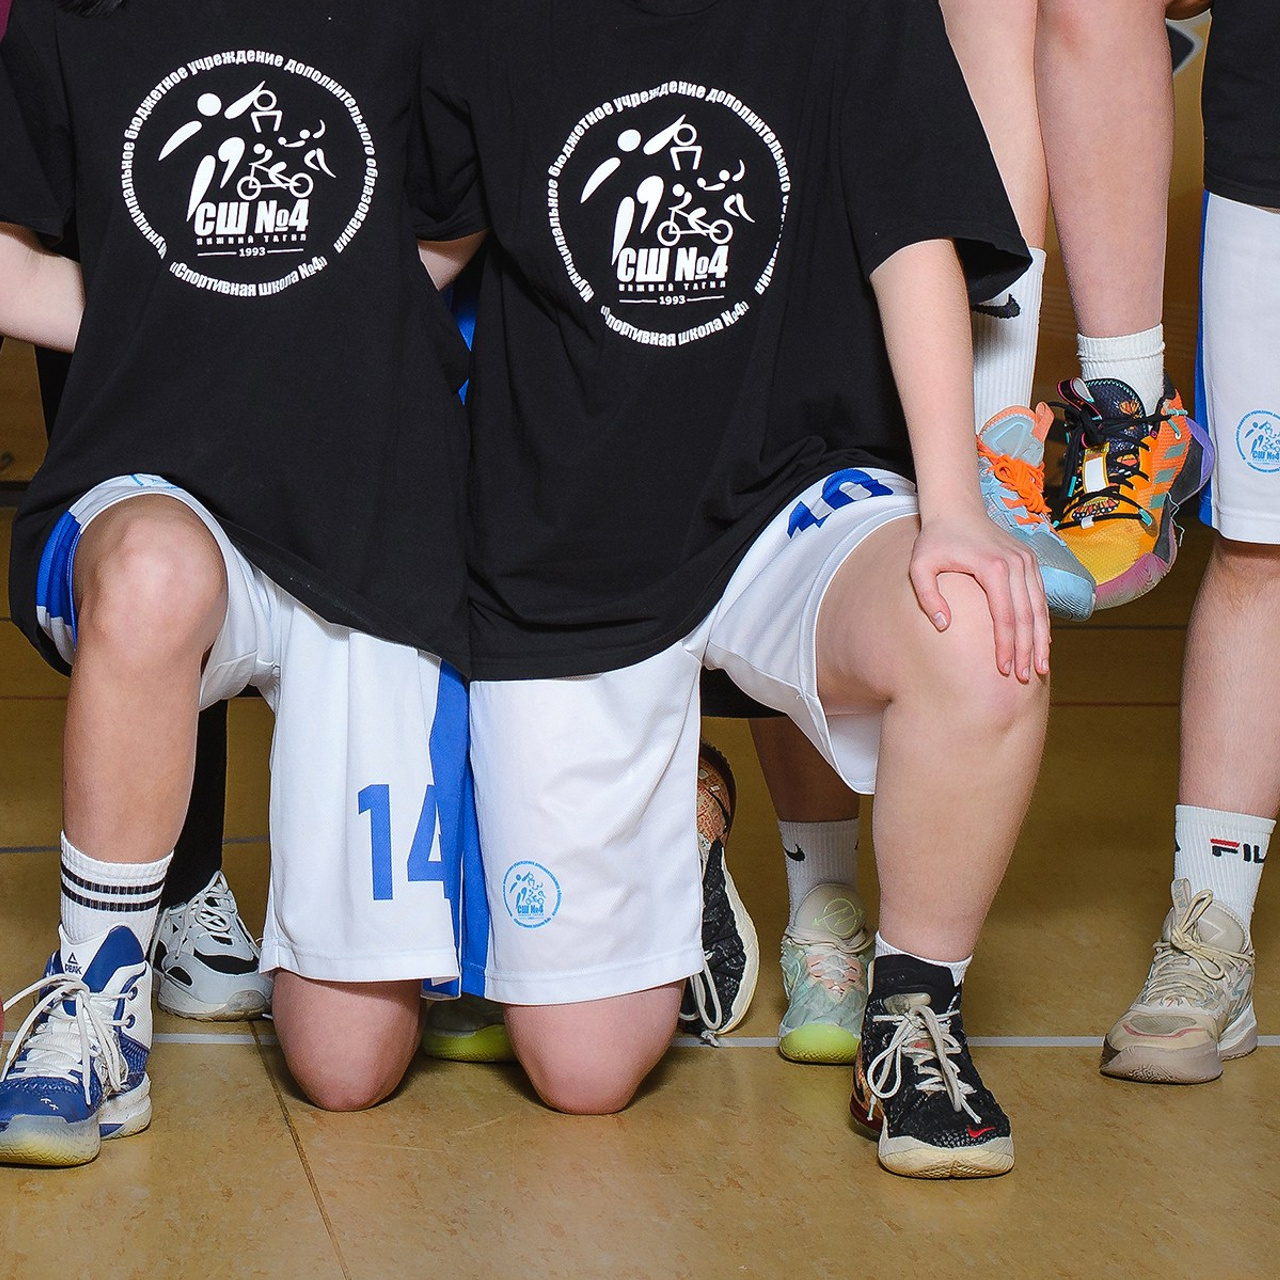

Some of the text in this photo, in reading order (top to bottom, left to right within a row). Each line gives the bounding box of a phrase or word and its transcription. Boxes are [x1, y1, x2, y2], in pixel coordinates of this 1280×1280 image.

[124, 67, 188, 140] бюджетное
[187, 50, 283, 75] учреждение
[284, 58, 375, 155] дополнительного
[333, 158, 378, 253] образования
[548, 80, 791, 303] Муниципальное бюджетное учреждение дополнительного
[194, 201, 249, 236] СШ
[239, 247, 265, 257] 1993
[617, 247, 669, 282] СШ
[258, 271, 299, 296] школа
[659, 295, 685, 305] 1993
[678, 319, 723, 345] школа
[358, 784, 452, 900] 14
[1210, 838, 1266, 864] FIL
[65, 963, 82, 975] PEAK
